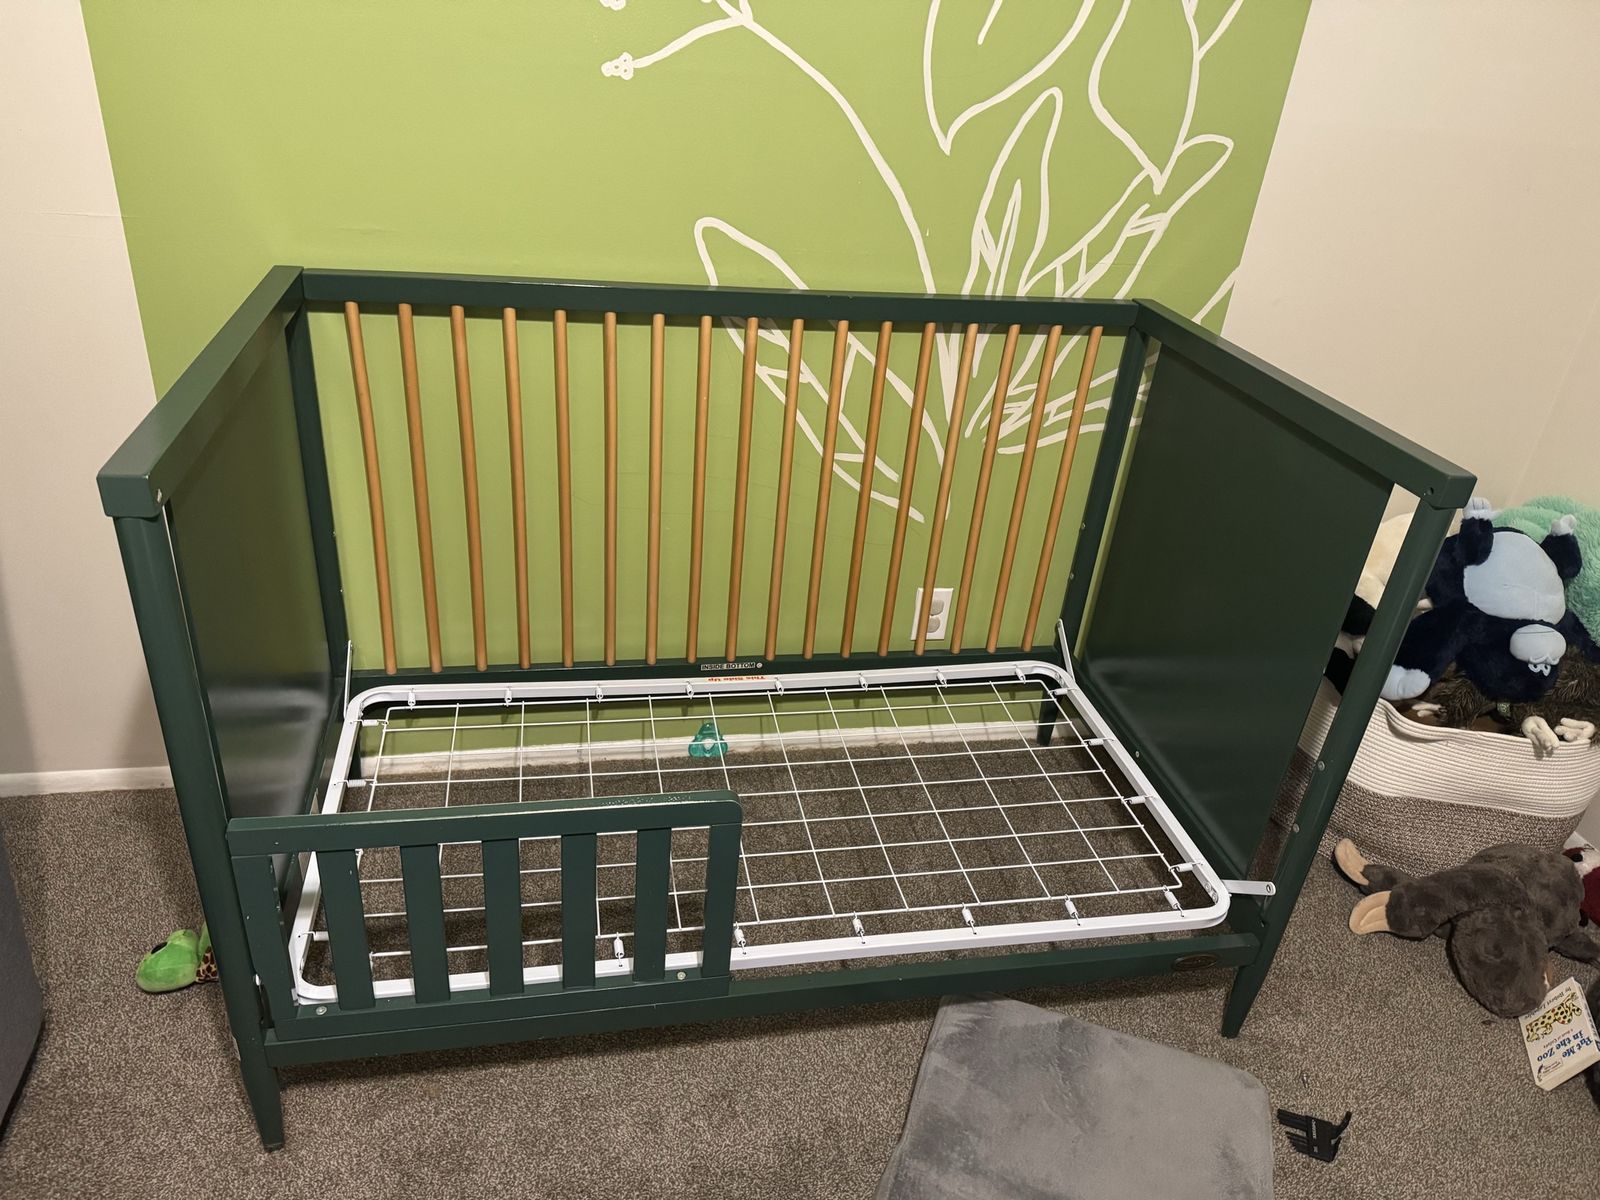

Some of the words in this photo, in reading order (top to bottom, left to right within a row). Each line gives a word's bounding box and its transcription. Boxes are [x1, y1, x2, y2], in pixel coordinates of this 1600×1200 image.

[1572, 1030, 1583, 1040] in
[1556, 1037, 1571, 1050] the
[1577, 1036, 1593, 1049] Put
[1537, 1047, 1555, 1062] Zoo
[1562, 1045, 1576, 1058] Me
